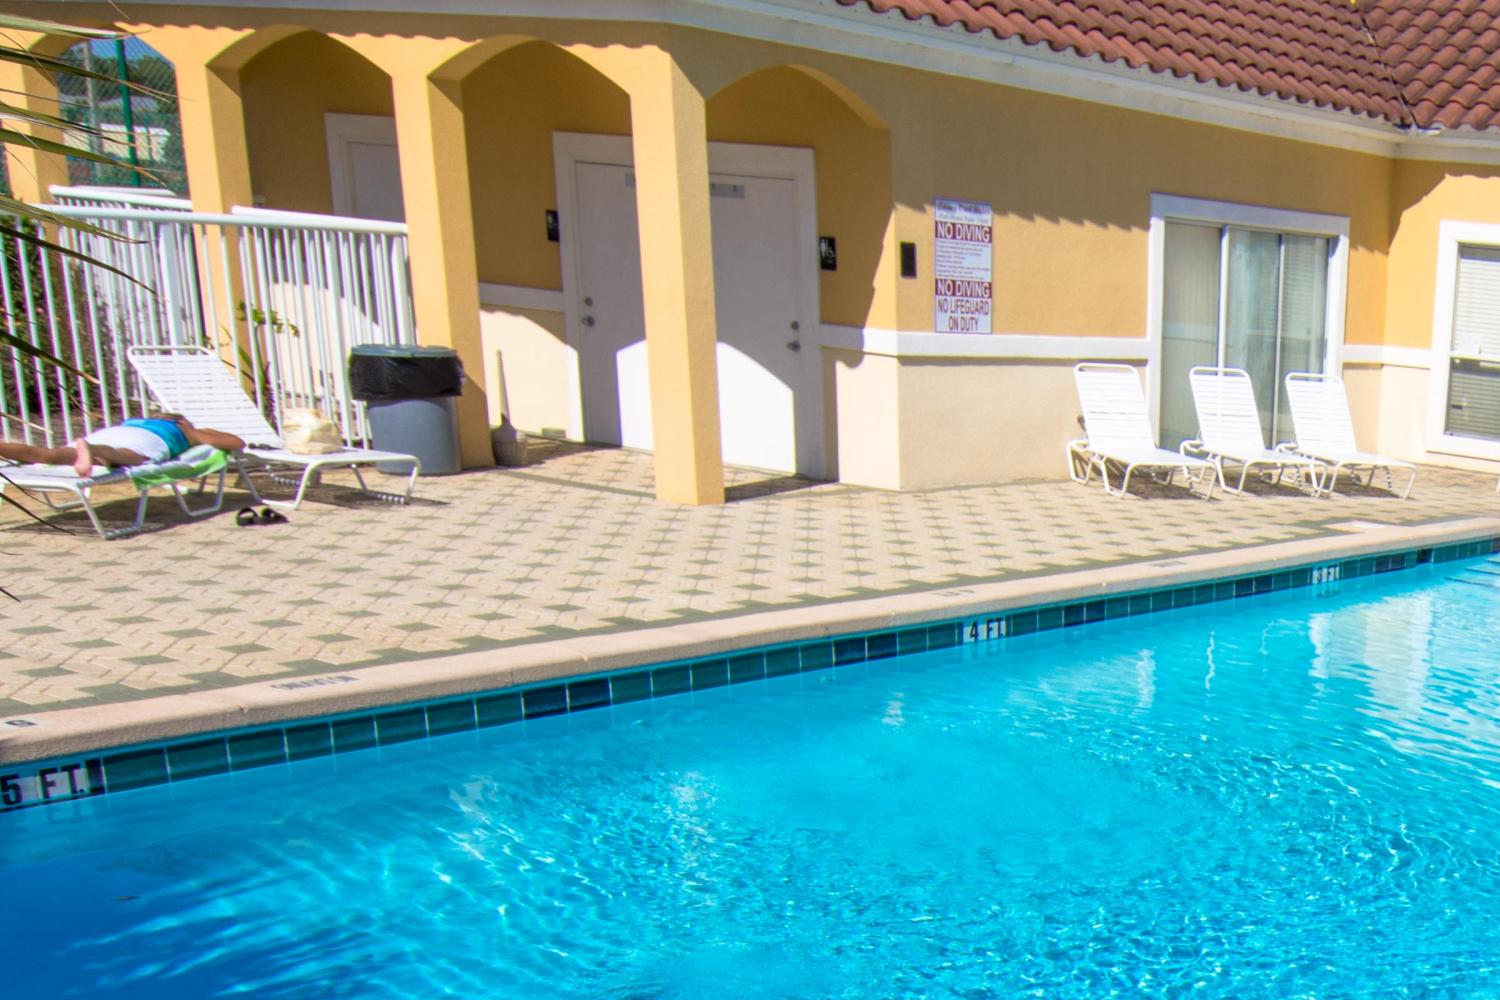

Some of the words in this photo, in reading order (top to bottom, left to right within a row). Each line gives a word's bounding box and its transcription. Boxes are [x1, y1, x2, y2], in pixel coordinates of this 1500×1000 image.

[937, 222, 953, 239] NO
[955, 223, 990, 242] DIVING
[937, 279, 953, 296] NO
[955, 280, 990, 298] DIVING
[938, 298, 948, 314] NO
[950, 299, 990, 315] LIFEGUARD
[949, 316, 959, 331] ON
[960, 316, 980, 331] DUTY
[969, 620, 979, 642] 4
[0, 774, 23, 806] 5
